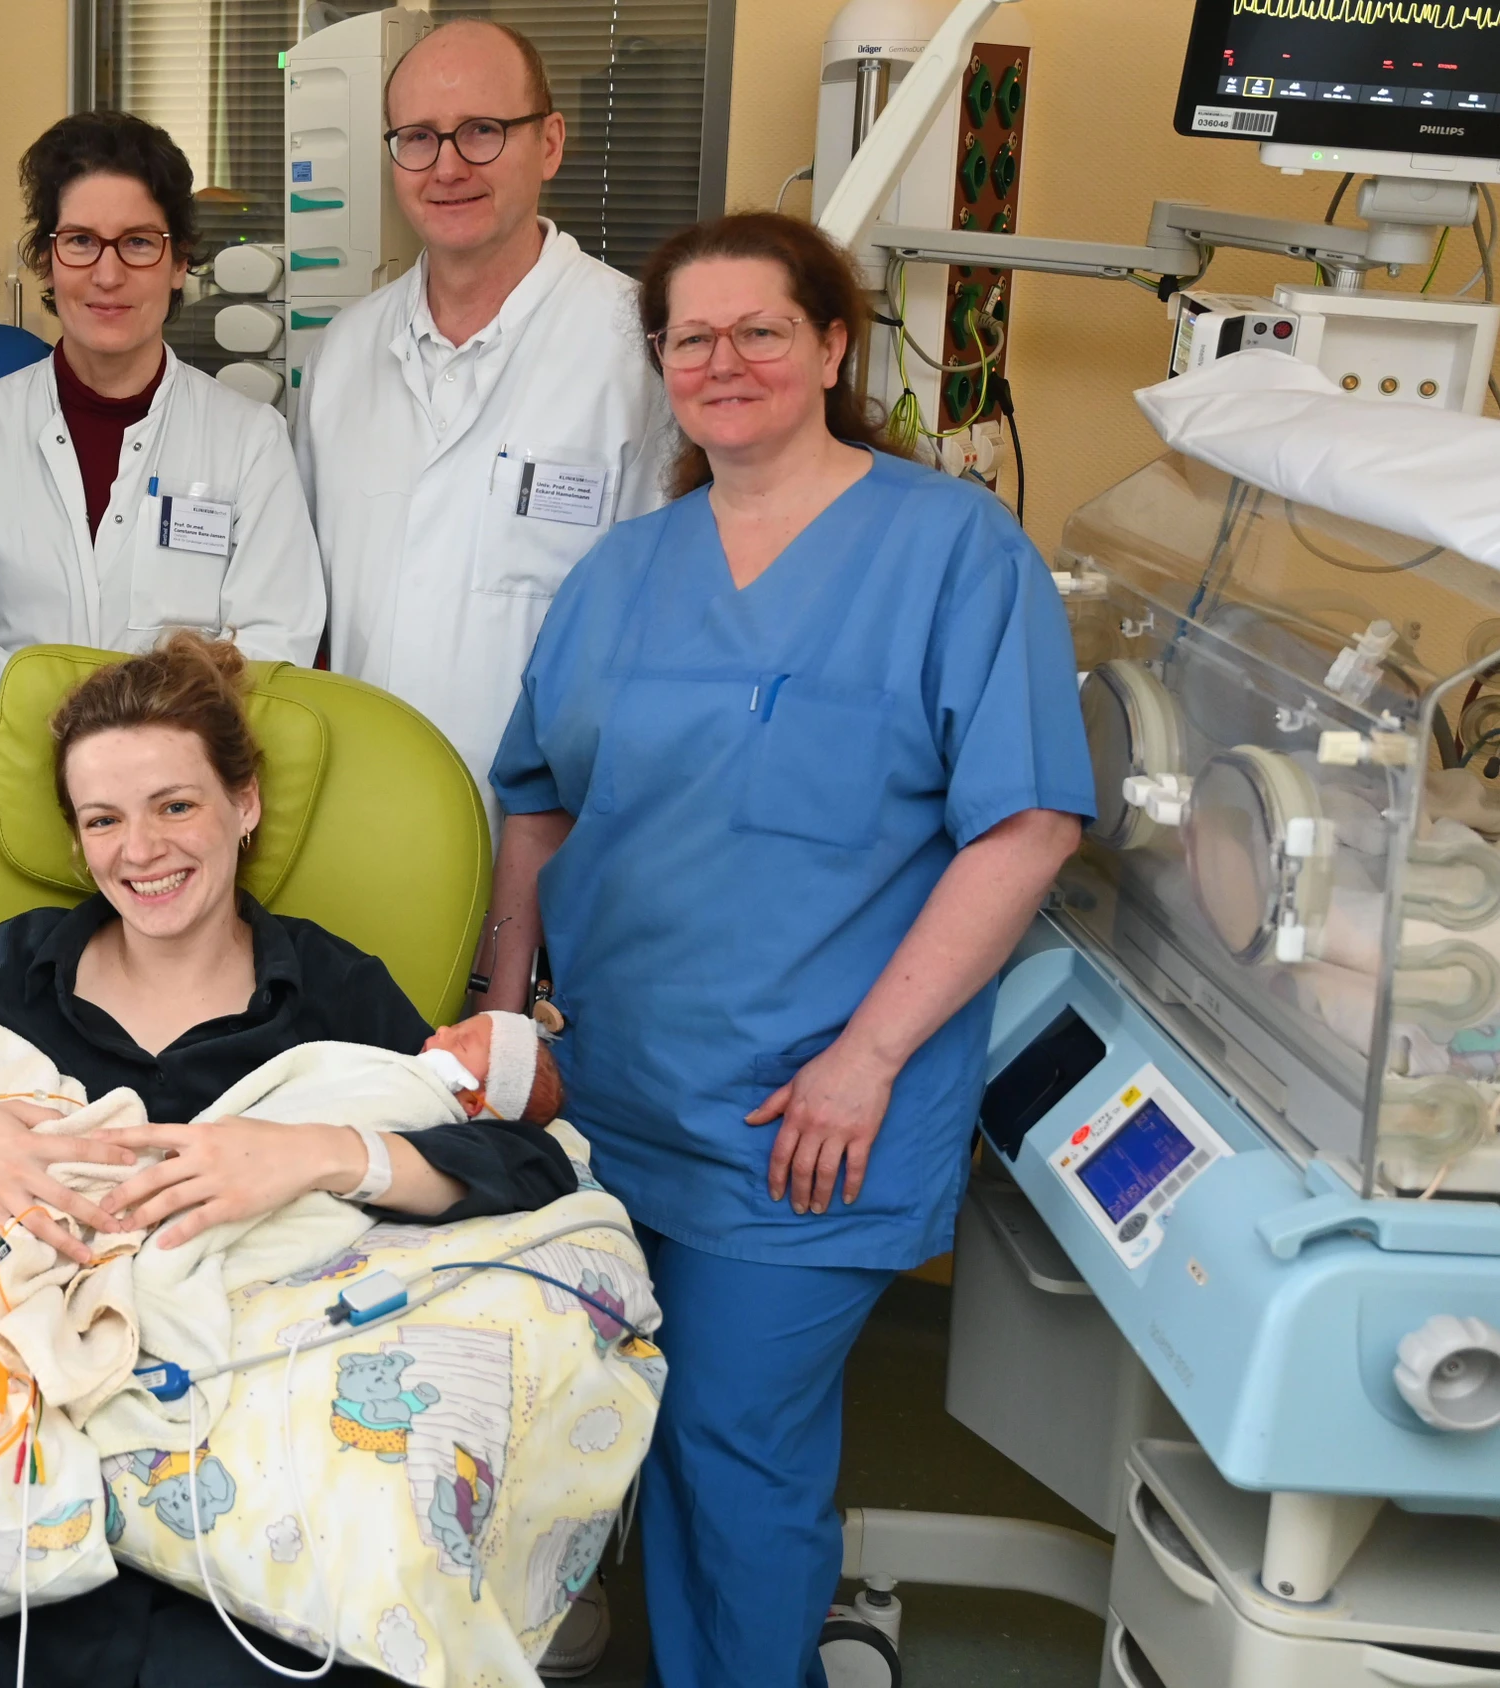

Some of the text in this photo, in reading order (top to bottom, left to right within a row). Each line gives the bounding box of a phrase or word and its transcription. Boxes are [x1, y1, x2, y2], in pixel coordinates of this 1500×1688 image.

[857, 44, 882, 54] Dräger
[1197, 118, 1229, 128] 036048
[1419, 124, 1465, 137] PHILIPS
[536, 481, 551, 489] Univ.
[552, 483, 566, 491] Prof.
[535, 488, 590, 500] Eckard Hamelmann
